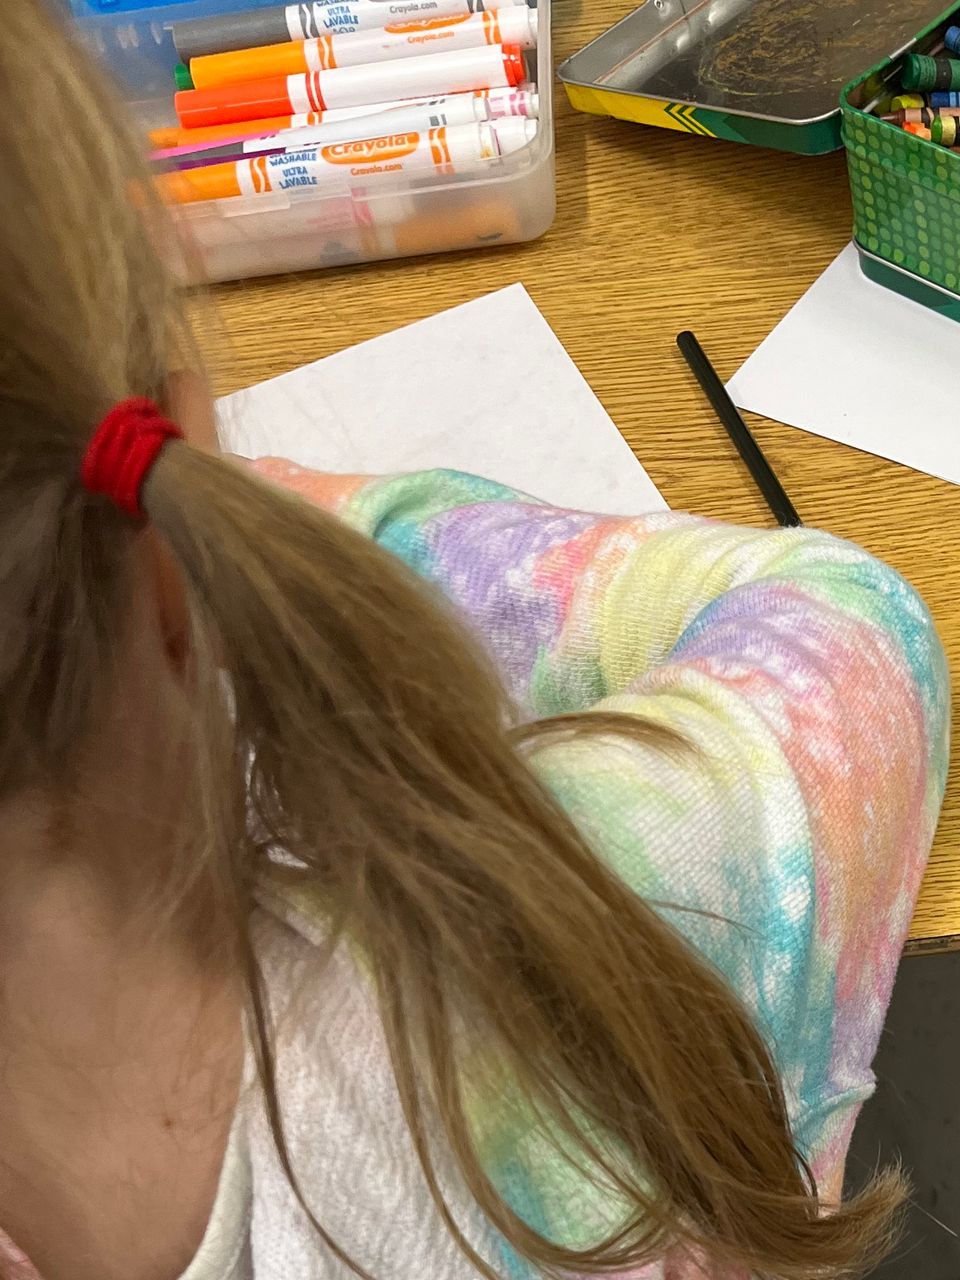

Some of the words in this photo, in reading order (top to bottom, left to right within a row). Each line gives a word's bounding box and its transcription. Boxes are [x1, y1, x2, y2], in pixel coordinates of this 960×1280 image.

[327, 6, 351, 16] ULTRA
[389, 2, 438, 15] Crayola.com
[323, 15, 359, 28] LAVABLE
[328, 134, 410, 157] Crayola
[269, 152, 317, 167] WASHABLE
[282, 166, 308, 177] ULTRA
[350, 163, 404, 177] Crayola.com
[279, 176, 318, 190] LAVABLE
